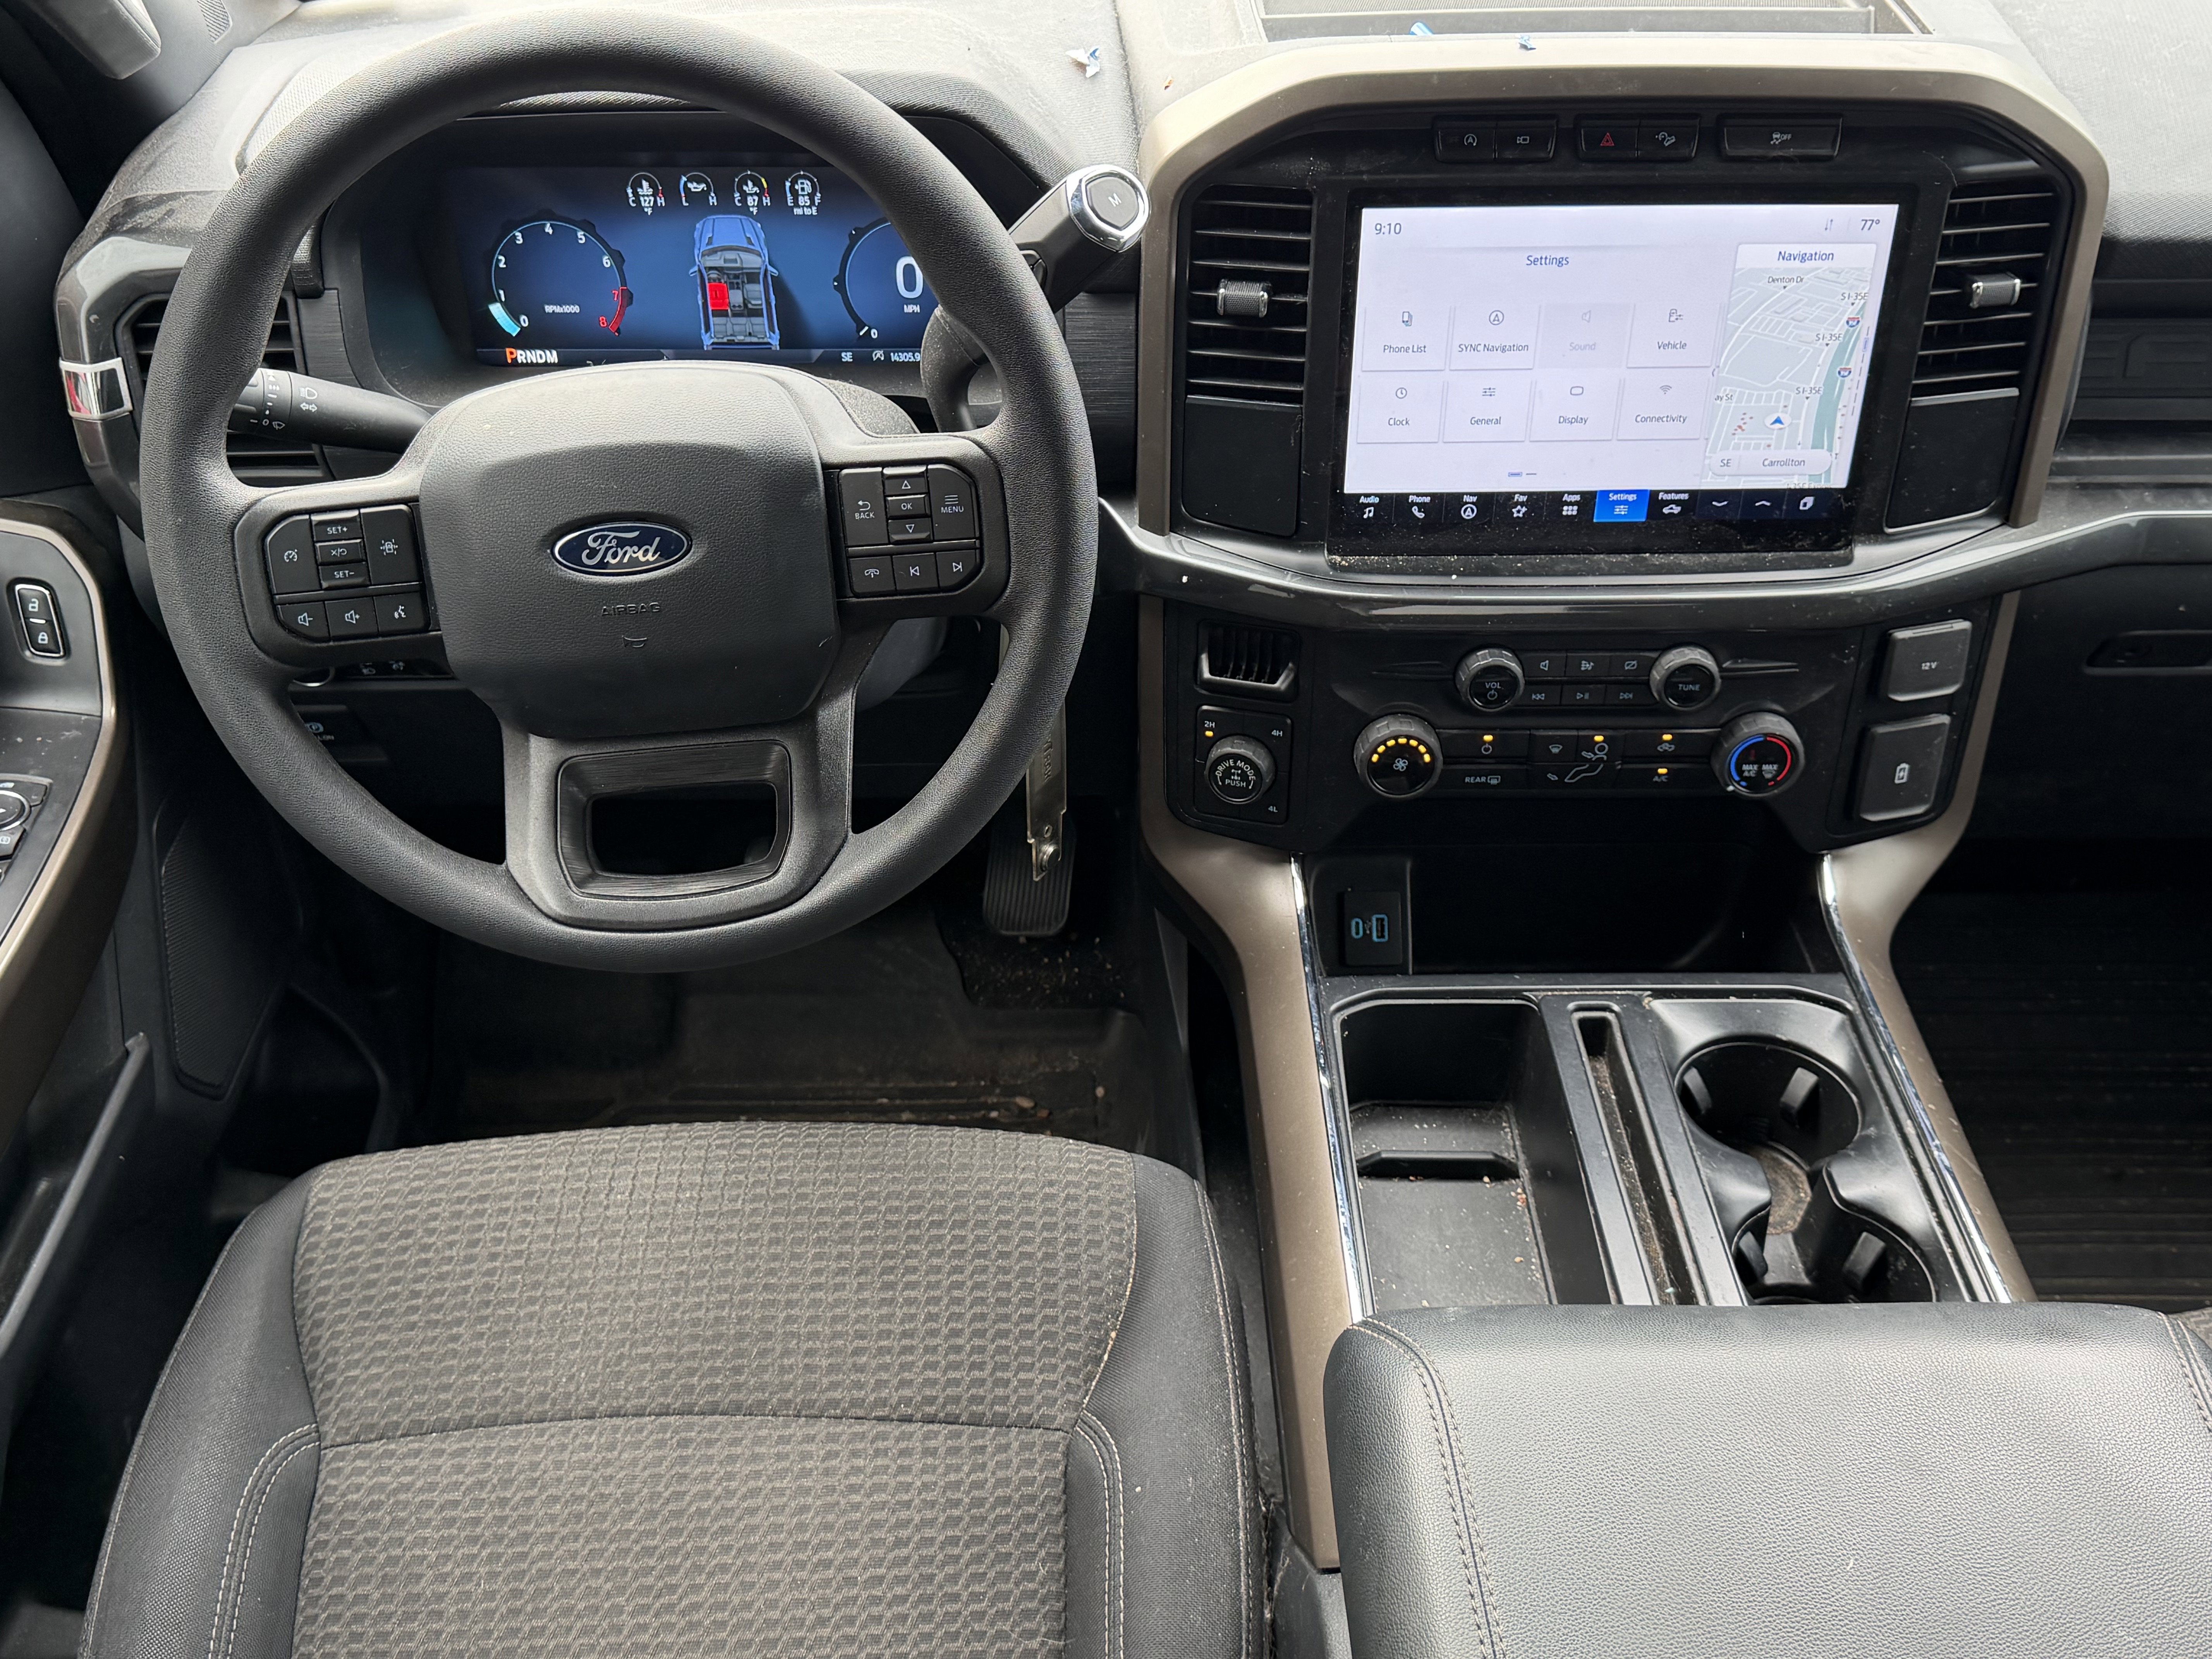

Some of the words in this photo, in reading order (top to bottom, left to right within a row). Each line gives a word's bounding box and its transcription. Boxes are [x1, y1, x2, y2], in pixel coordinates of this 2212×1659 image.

[629, 197, 636, 206] C
[640, 196, 654, 206] 127
[657, 196, 665, 206] H
[682, 197, 689, 206] L
[709, 196, 717, 206] H
[735, 197, 742, 206] C
[747, 195, 758, 206] 87
[763, 196, 771, 206] H
[787, 196, 794, 206] E
[798, 195, 810, 206] 85
[814, 196, 821, 206] F
[1108, 193, 1122, 207] M
[794, 206, 804, 215] mi
[804, 206, 812, 215] to
[812, 206, 818, 215] E
[544, 223, 553, 235] 4
[1374, 223, 1402, 235] 9:10
[1861, 219, 1880, 231] 77°
[514, 232, 523, 244] 3
[577, 231, 586, 244] 5
[498, 255, 506, 268] 2
[602, 255, 611, 268] 6
[1525, 254, 1570, 268] Settings
[1778, 251, 1834, 263] Navigation
[896, 256, 924, 299] 0
[498, 289, 505, 302] 1
[612, 290, 618, 301] 7
[1841, 292, 1846, 301] S
[903, 304, 921, 313] MPH
[519, 314, 529, 327] 0
[598, 316, 608, 327] 8
[871, 328, 878, 338] 0
[1382, 344, 1409, 354] Phone
[1410, 343, 1427, 354] List
[1458, 343, 1481, 353] SYNC
[1483, 342, 1529, 354] Navigation
[1569, 342, 1596, 352] Sound
[1657, 340, 1687, 350] Vehicle
[841, 352, 853, 362] SE
[890, 352, 921, 362] 14305.9
[1388, 417, 1410, 427] Clock
[1470, 416, 1501, 426] General
[1558, 415, 1589, 427] Display
[1635, 414, 1687, 425] Connectivity
[1720, 459, 1732, 467] SE
[1762, 458, 1805, 467] Carrollton
[1514, 494, 1528, 502] Fav
[1562, 493, 1581, 502] Apps
[1608, 492, 1637, 501] Settings
[1658, 492, 1689, 500] Features
[327, 526, 348, 534] SET+
[581, 531, 661, 566] Ford
[601, 602, 661, 617] AIRBAG
[1215, 759, 1235, 777] DRIVE
[1236, 760, 1256, 780] MODE
[1225, 779, 1246, 788] PUSH
